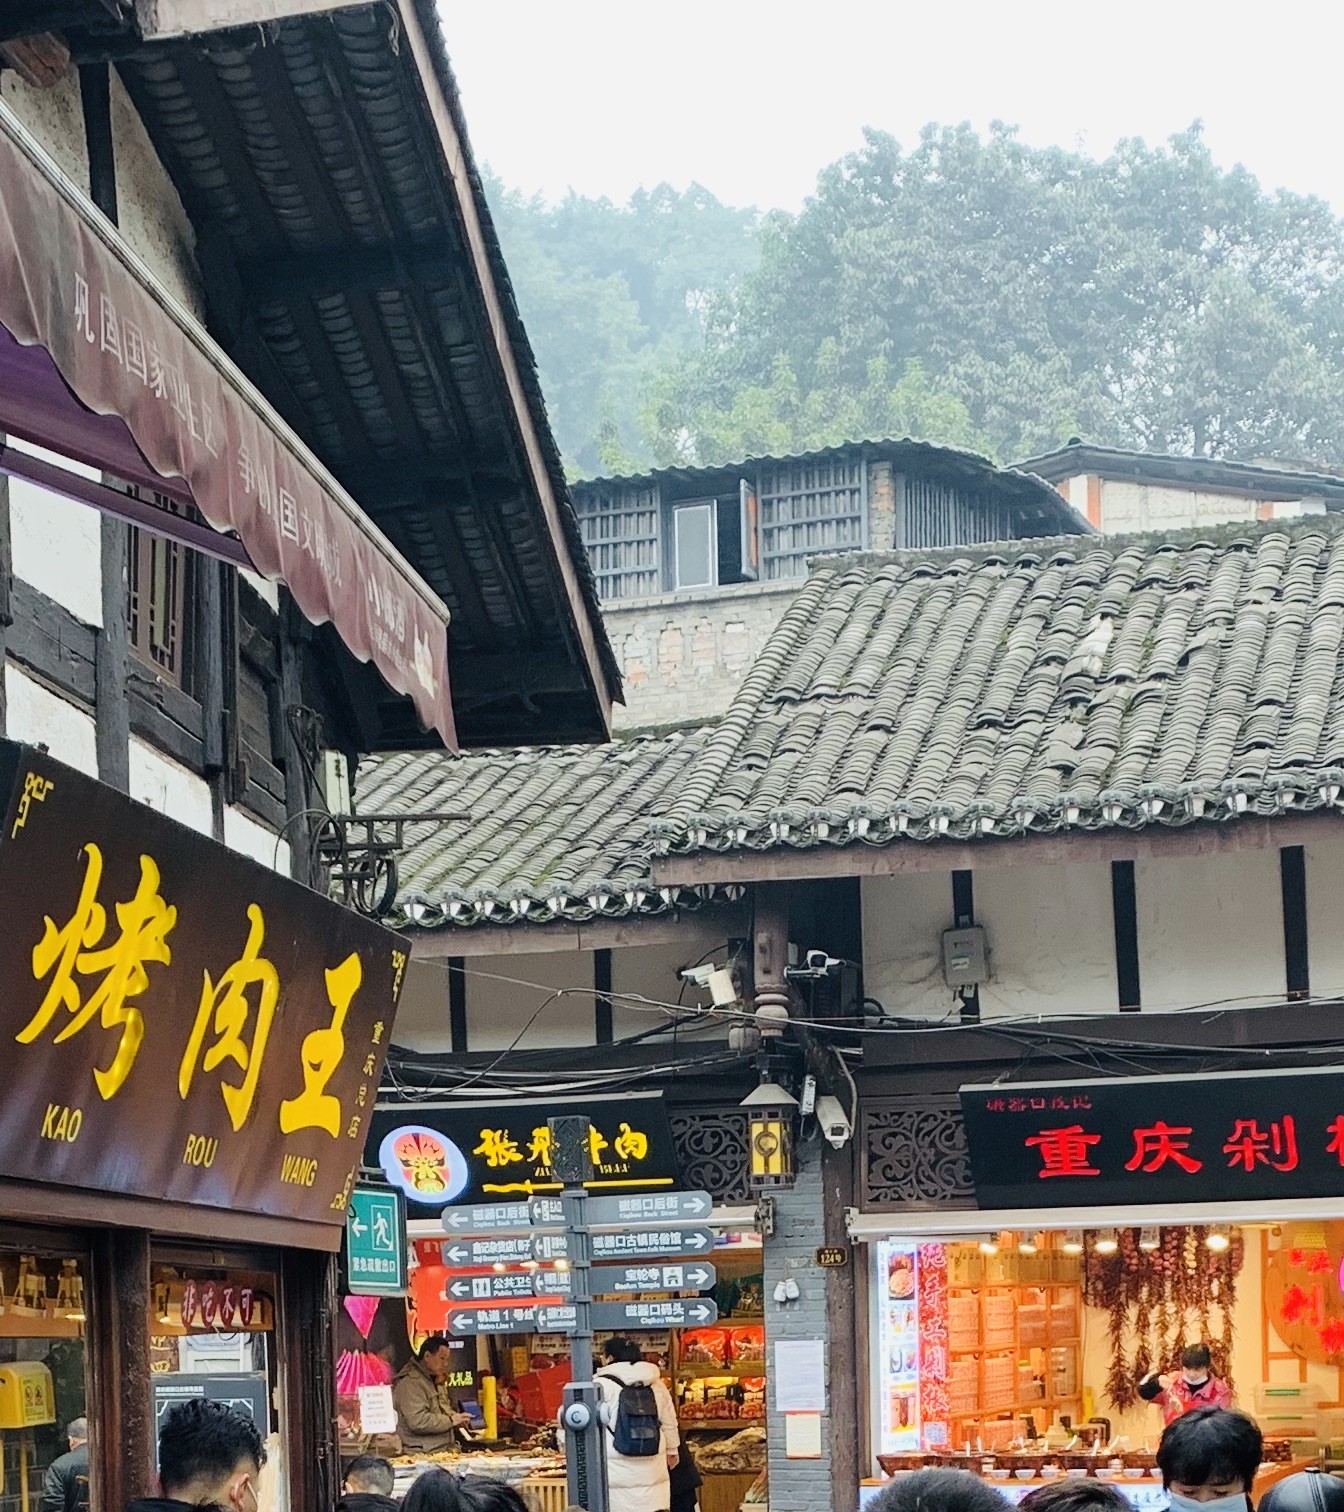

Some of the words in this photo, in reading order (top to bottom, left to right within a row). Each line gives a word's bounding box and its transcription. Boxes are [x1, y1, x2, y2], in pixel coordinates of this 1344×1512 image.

[15, 842, 363, 1139] 烤肉王
[41, 1102, 82, 1144] KAO
[182, 1132, 218, 1170] ROU
[280, 1154, 318, 1189] WANG
[618, 1196, 679, 1212] 磁器口后街
[592, 1231, 682, 1250] 磁器口古镇民俗馆
[351, 1256, 396, 1274] 紧急疏散出口
[624, 1267, 660, 1282] 宝轮寺
[181, 1279, 255, 1327] 非吃不可
[624, 1302, 685, 1317] 磁器口码头
